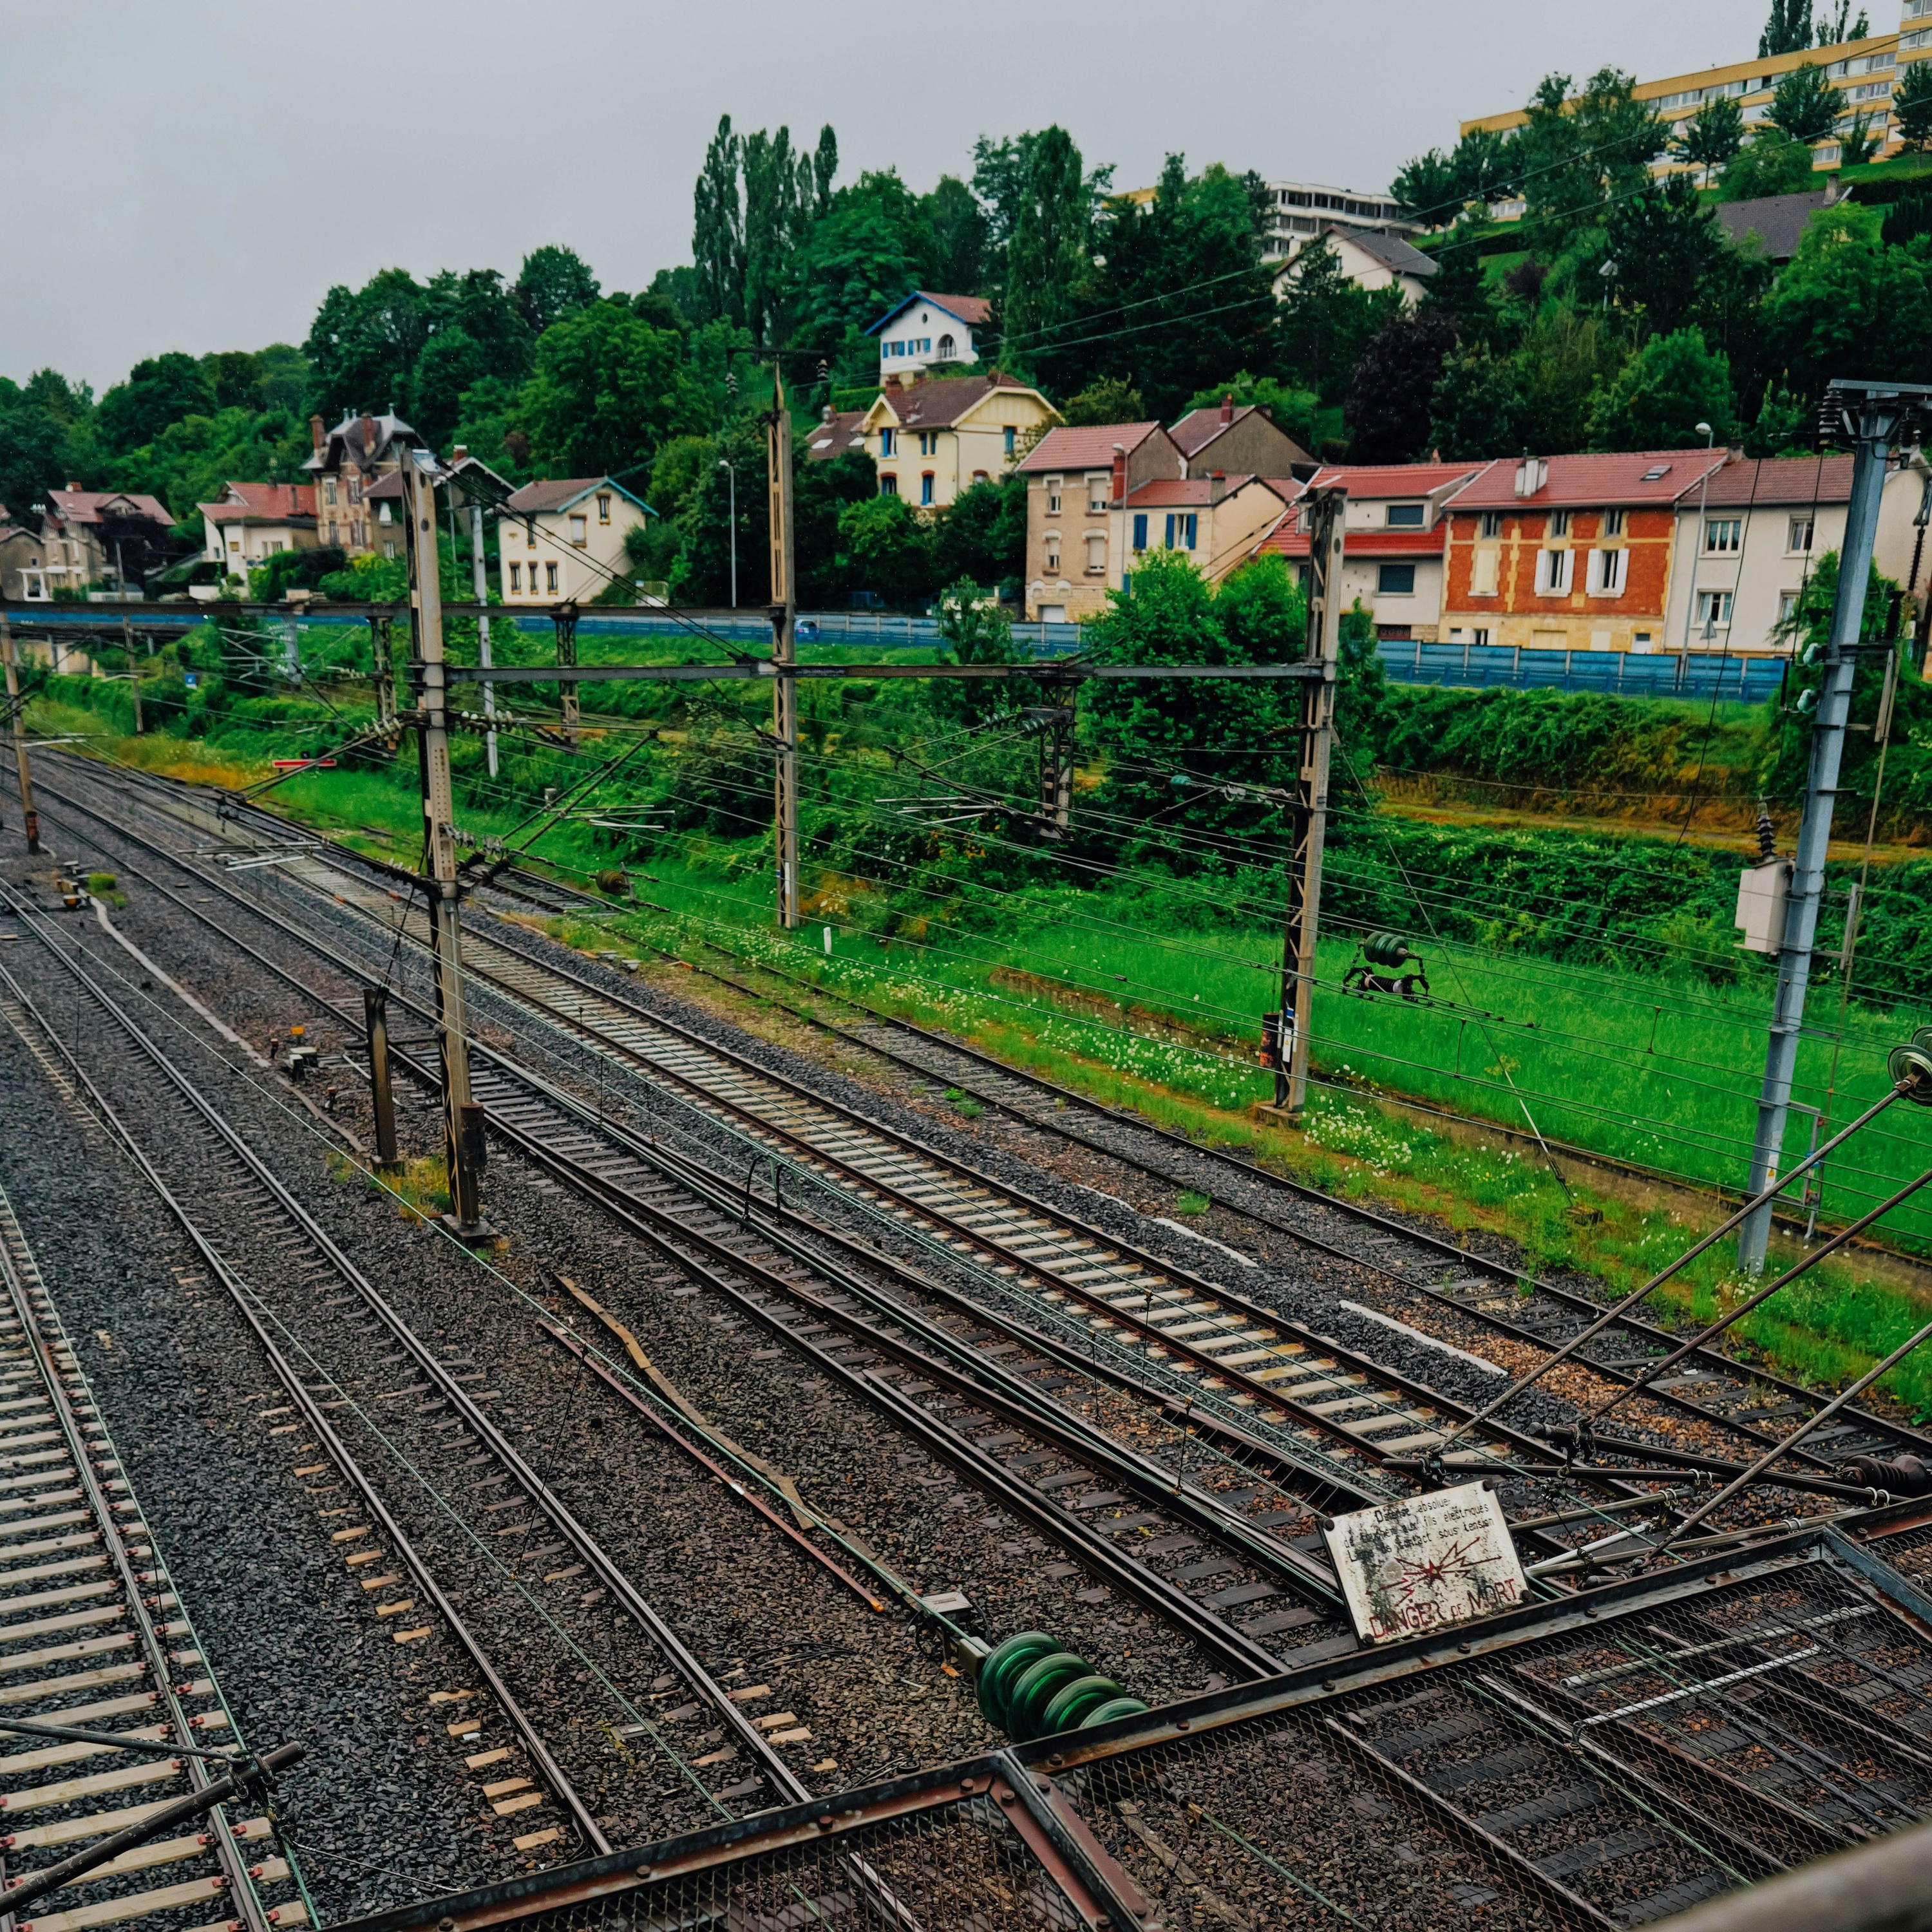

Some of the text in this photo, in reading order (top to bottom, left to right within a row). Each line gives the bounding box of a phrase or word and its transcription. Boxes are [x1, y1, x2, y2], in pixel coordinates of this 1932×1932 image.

[1423, 1514, 1437, 1527] fils
[1437, 1526, 1459, 1539] sous
[1463, 1517, 1495, 1532] tension
[1368, 1578, 1518, 1639] DANGER DE MORT
